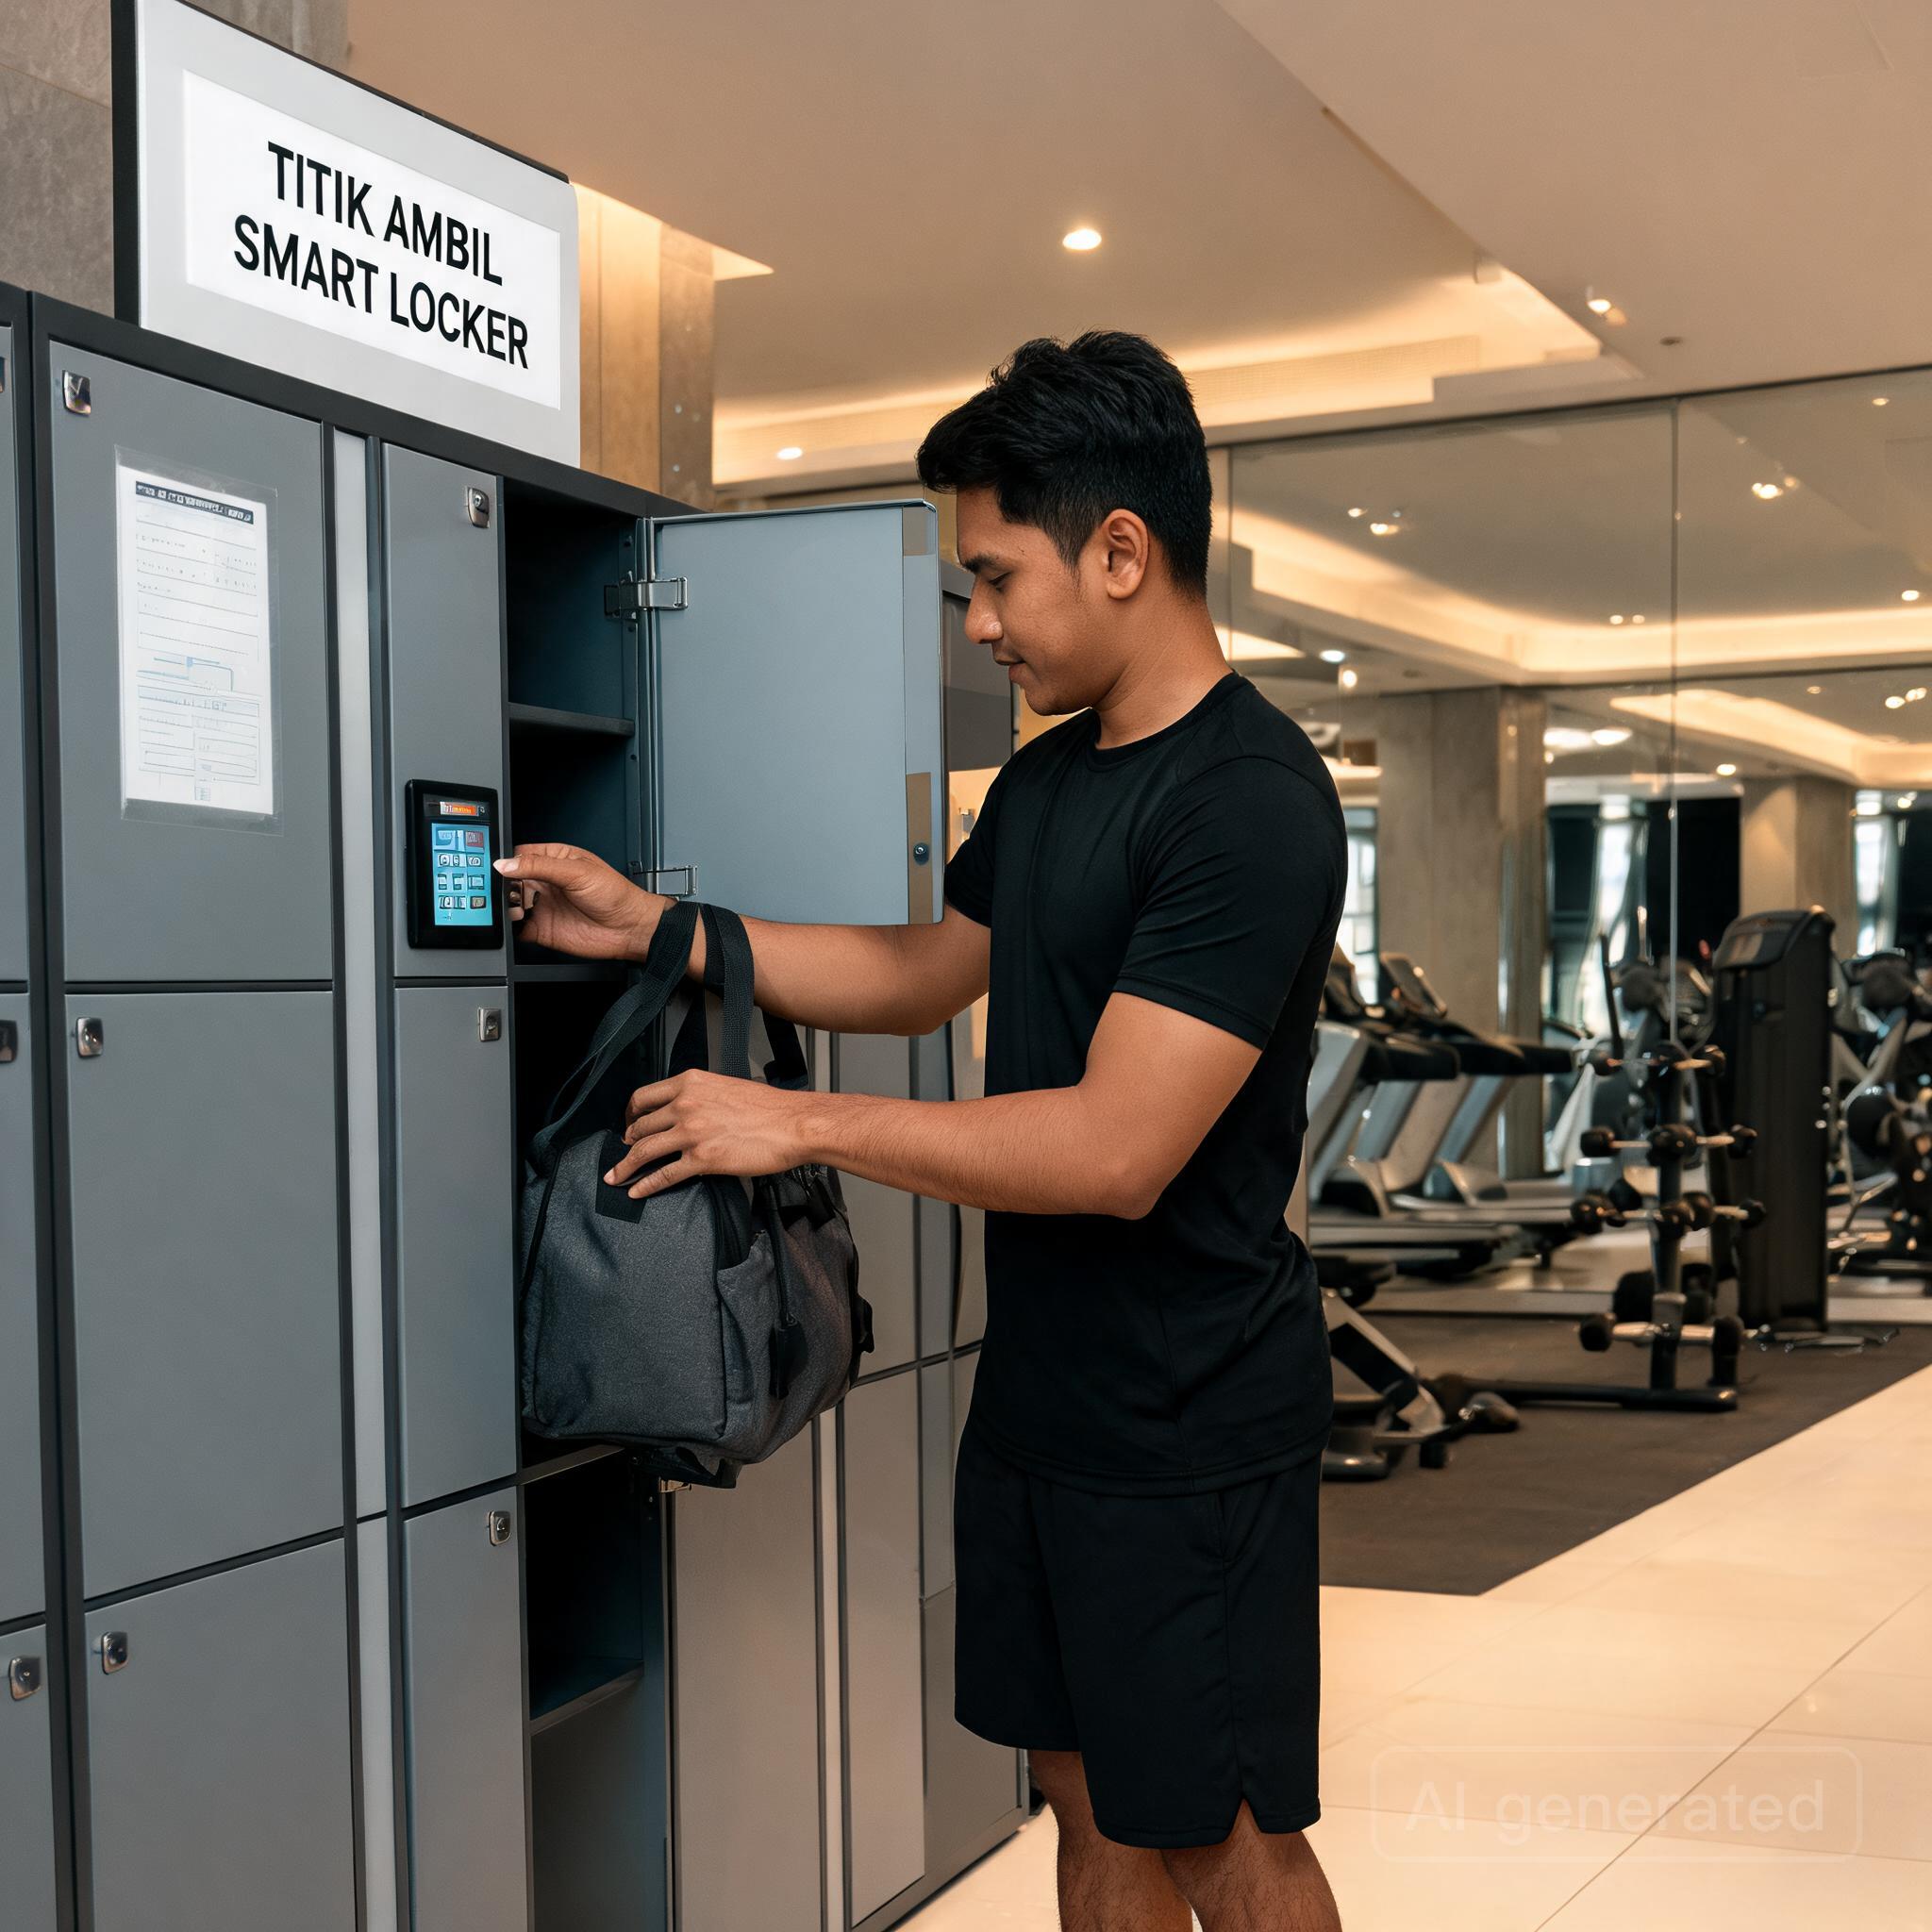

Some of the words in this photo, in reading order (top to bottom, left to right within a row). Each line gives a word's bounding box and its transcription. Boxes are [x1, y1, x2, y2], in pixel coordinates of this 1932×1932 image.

[268, 141, 375, 237] TITIK
[384, 194, 503, 286] AMBIL
[234, 215, 378, 314] SMART
[391, 272, 528, 369] LOCKER
